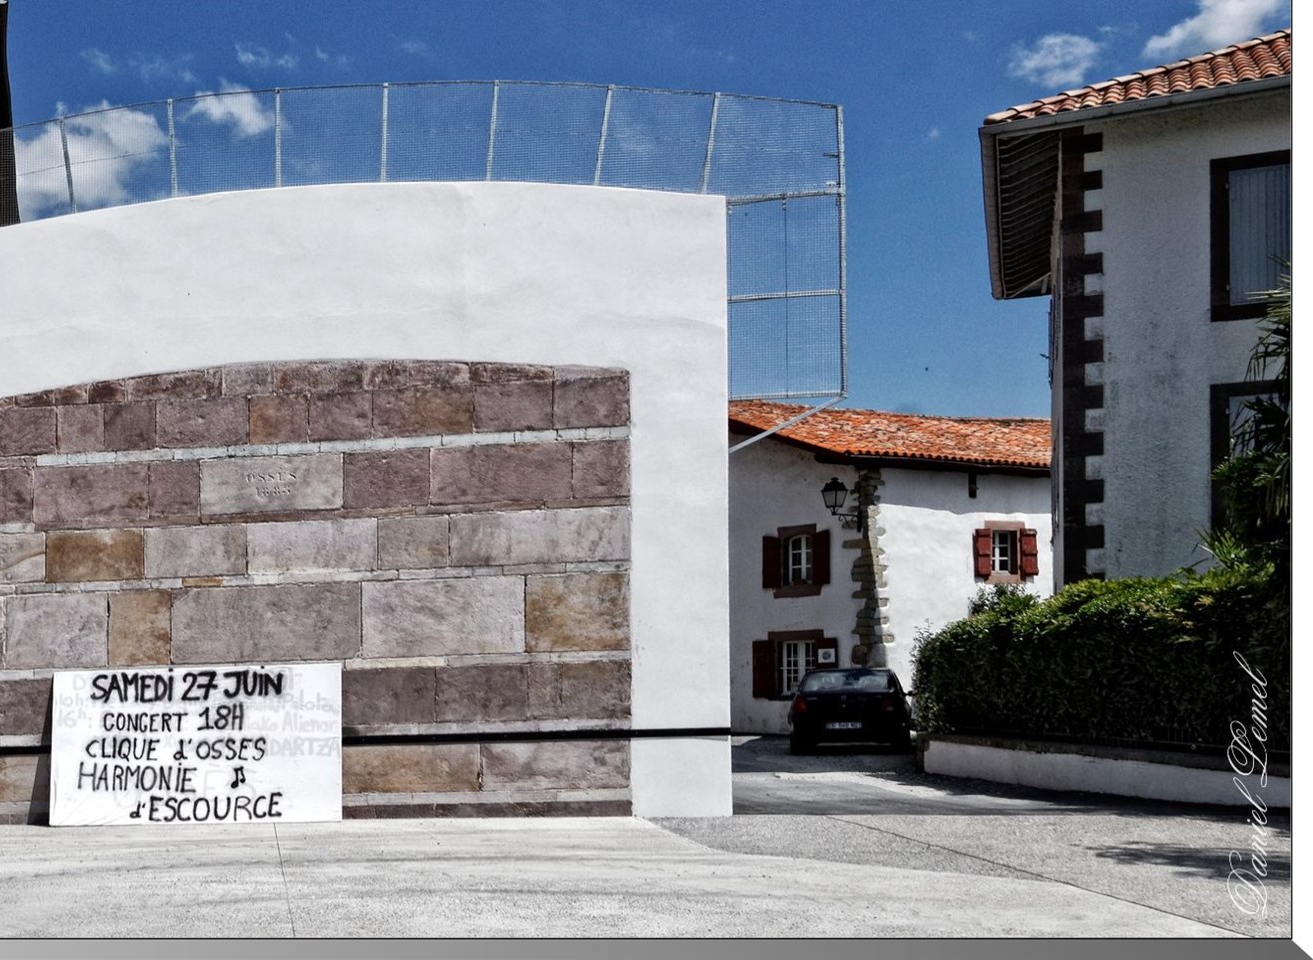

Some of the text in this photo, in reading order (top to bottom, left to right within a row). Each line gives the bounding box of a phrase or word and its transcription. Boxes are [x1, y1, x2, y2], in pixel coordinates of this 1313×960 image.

[181, 671, 218, 701] 27
[103, 712, 188, 732] CONCERT
[197, 702, 245, 731] 18H
[85, 737, 267, 761] CLIQUE d'OSSES
[129, 791, 283, 822] d'ESCOURCE
